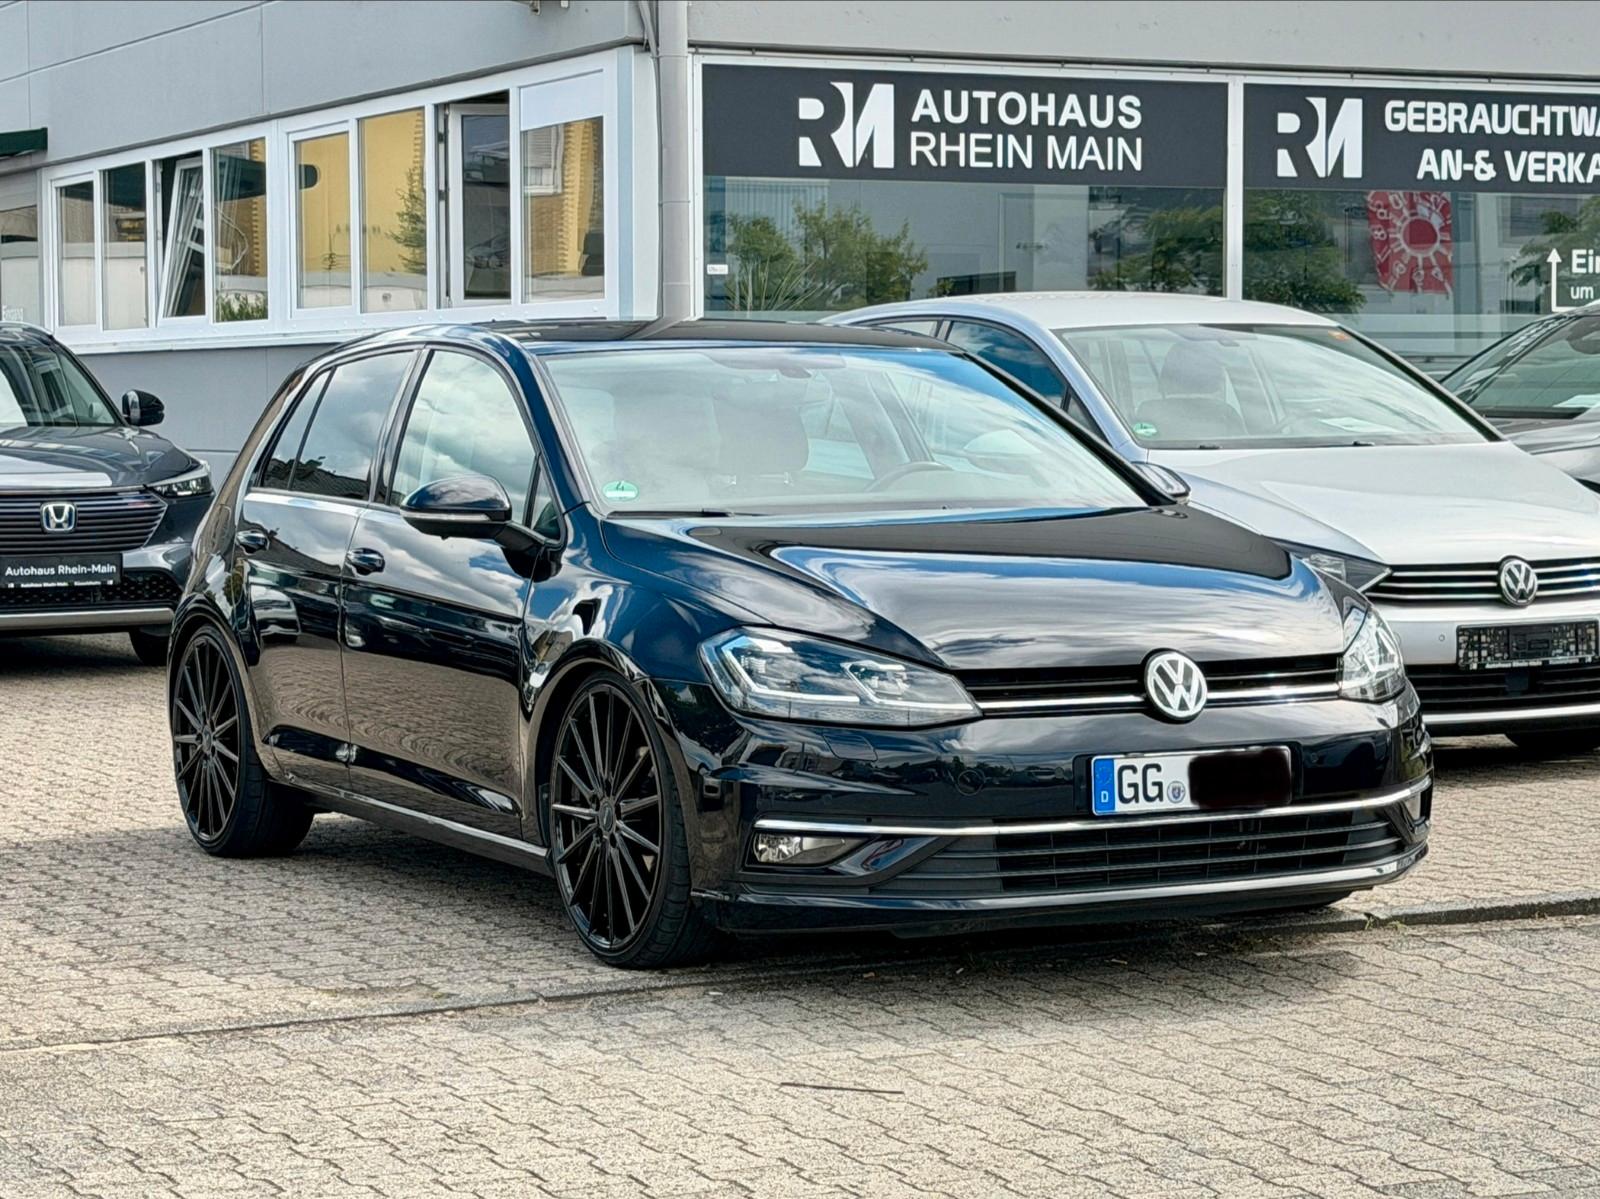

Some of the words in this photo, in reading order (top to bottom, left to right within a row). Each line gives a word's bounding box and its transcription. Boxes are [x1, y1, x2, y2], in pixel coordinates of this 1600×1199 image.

[911, 88, 1142, 130] AUTOHAUS
[1384, 99, 1600, 137] GEBRAUCHTW
[910, 131, 1033, 169] RHEIN
[1047, 134, 1142, 172] MAIN
[1570, 285, 1594, 300] um
[5, 566, 55, 576] Autohaus
[58, 564, 116, 575] Rhein-Main
[1148, 654, 1205, 716] VW
[1100, 790, 1109, 803] D
[1117, 762, 1164, 805] GG
